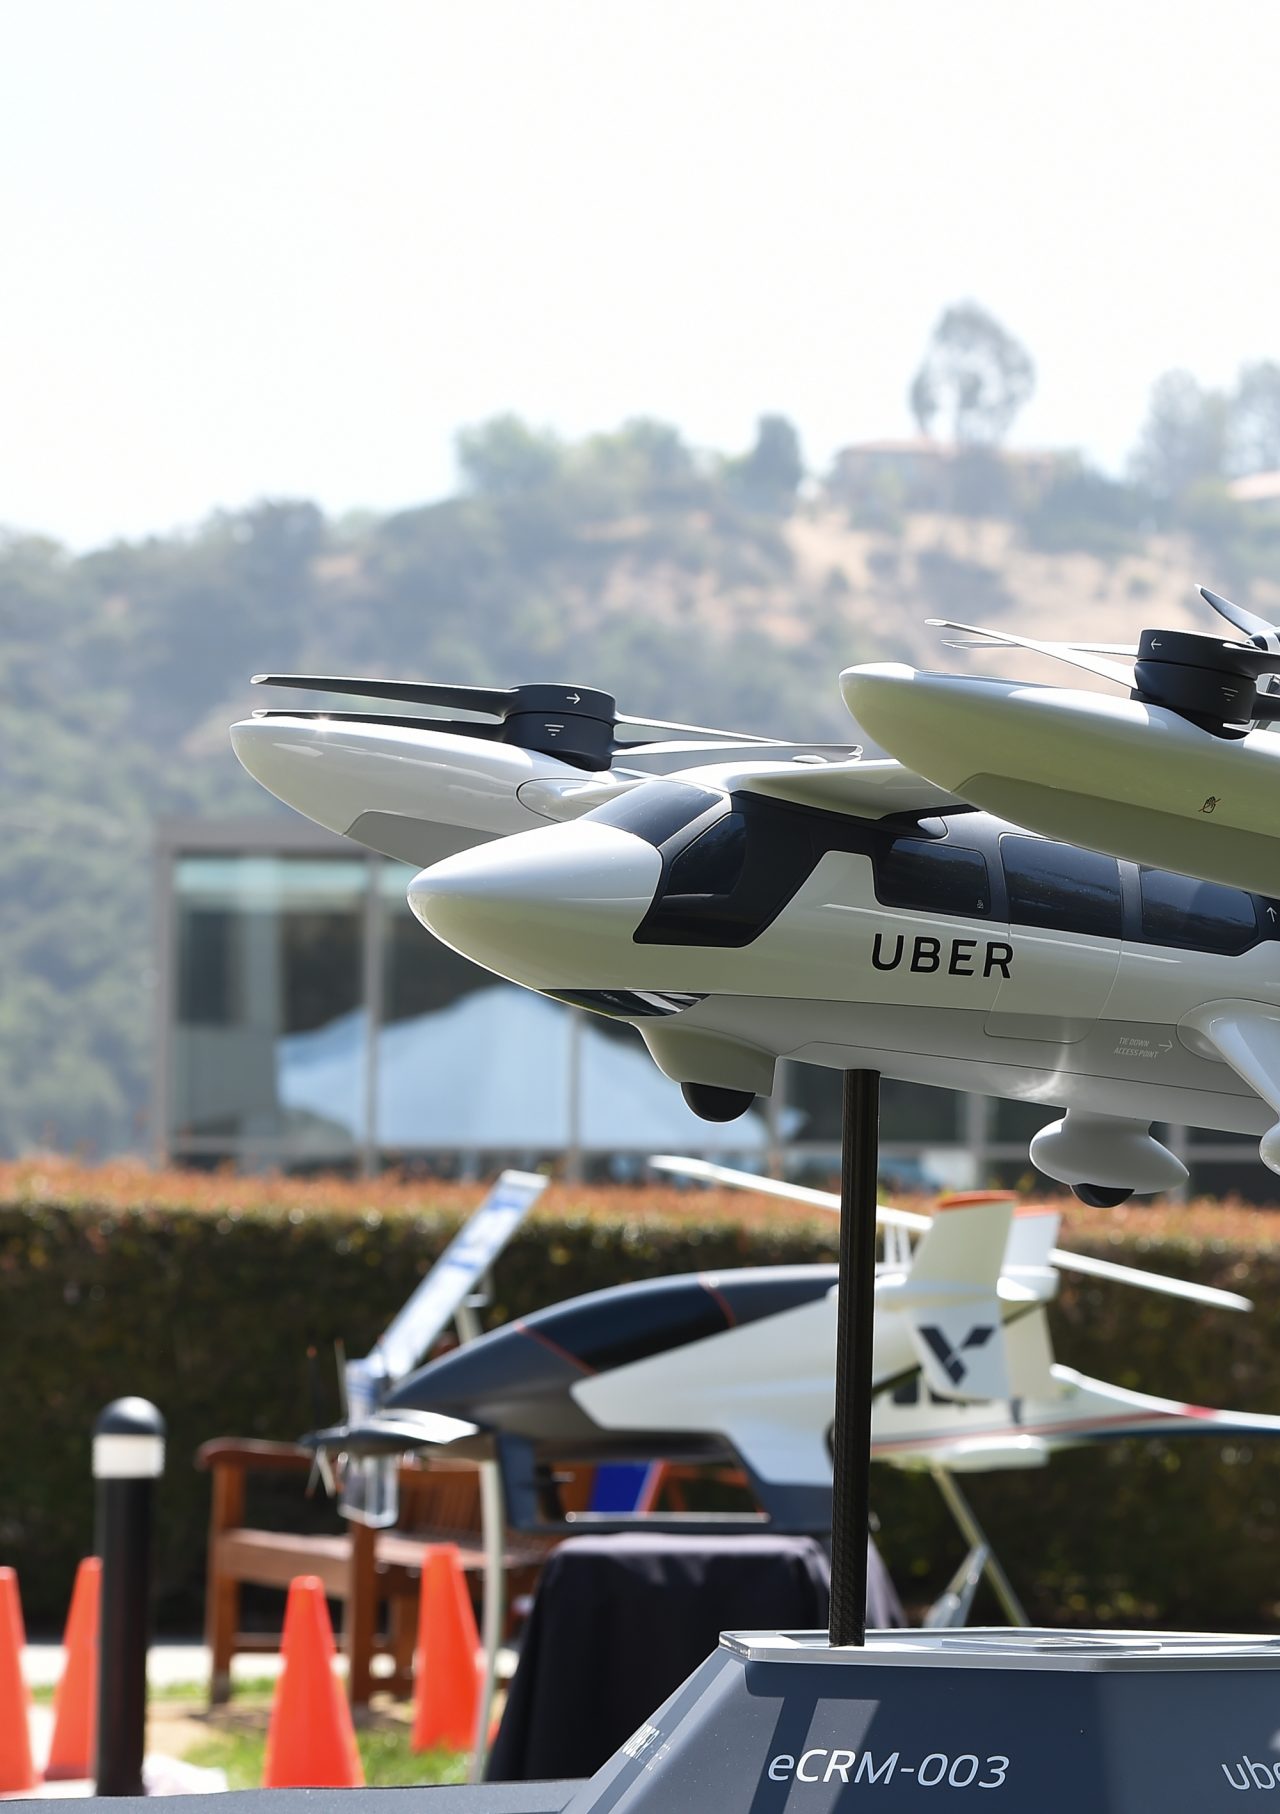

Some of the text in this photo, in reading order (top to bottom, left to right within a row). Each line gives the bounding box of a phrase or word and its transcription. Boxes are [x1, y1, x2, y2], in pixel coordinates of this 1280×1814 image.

[871, 933, 1014, 979] UBER
[1113, 1047, 1138, 1057] ACCESS
[767, 1748, 1010, 1789] eCRM-003
